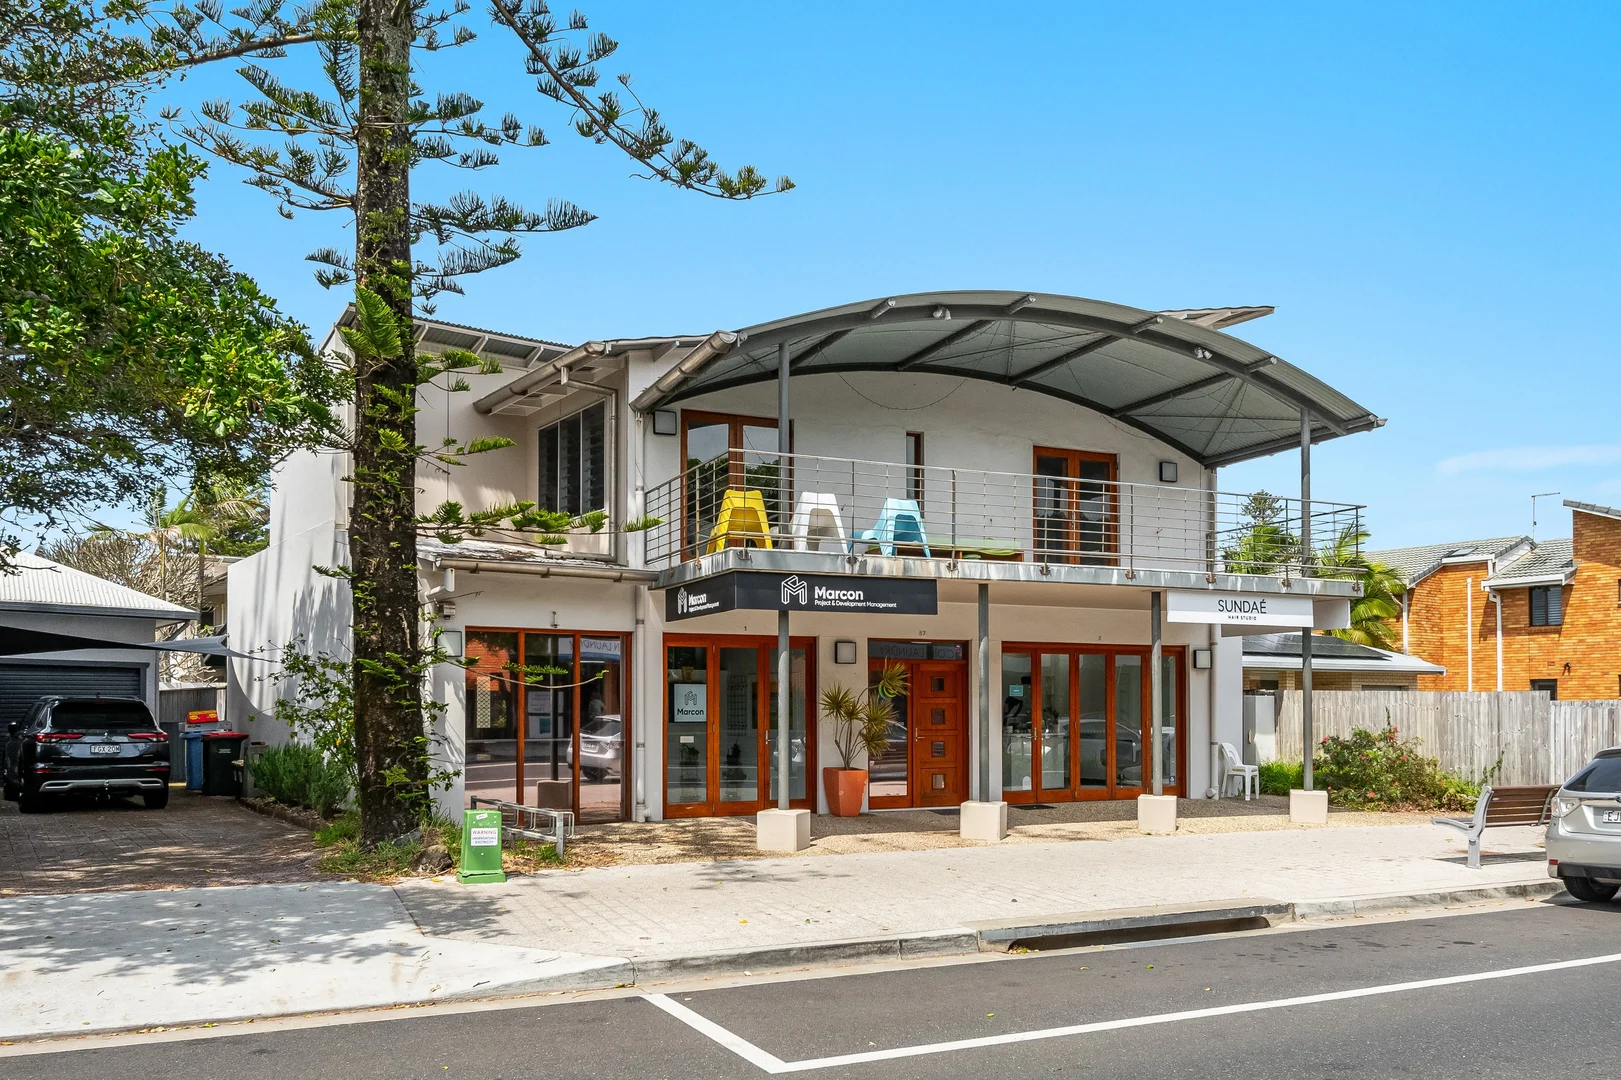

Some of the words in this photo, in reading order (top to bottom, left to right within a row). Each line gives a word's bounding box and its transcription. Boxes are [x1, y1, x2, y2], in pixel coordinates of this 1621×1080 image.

[688, 593, 706, 606] Marcon
[814, 586, 863, 600] Marcon
[1218, 599, 1266, 614] SUNDAÉ
[677, 708, 704, 716] Marcon
